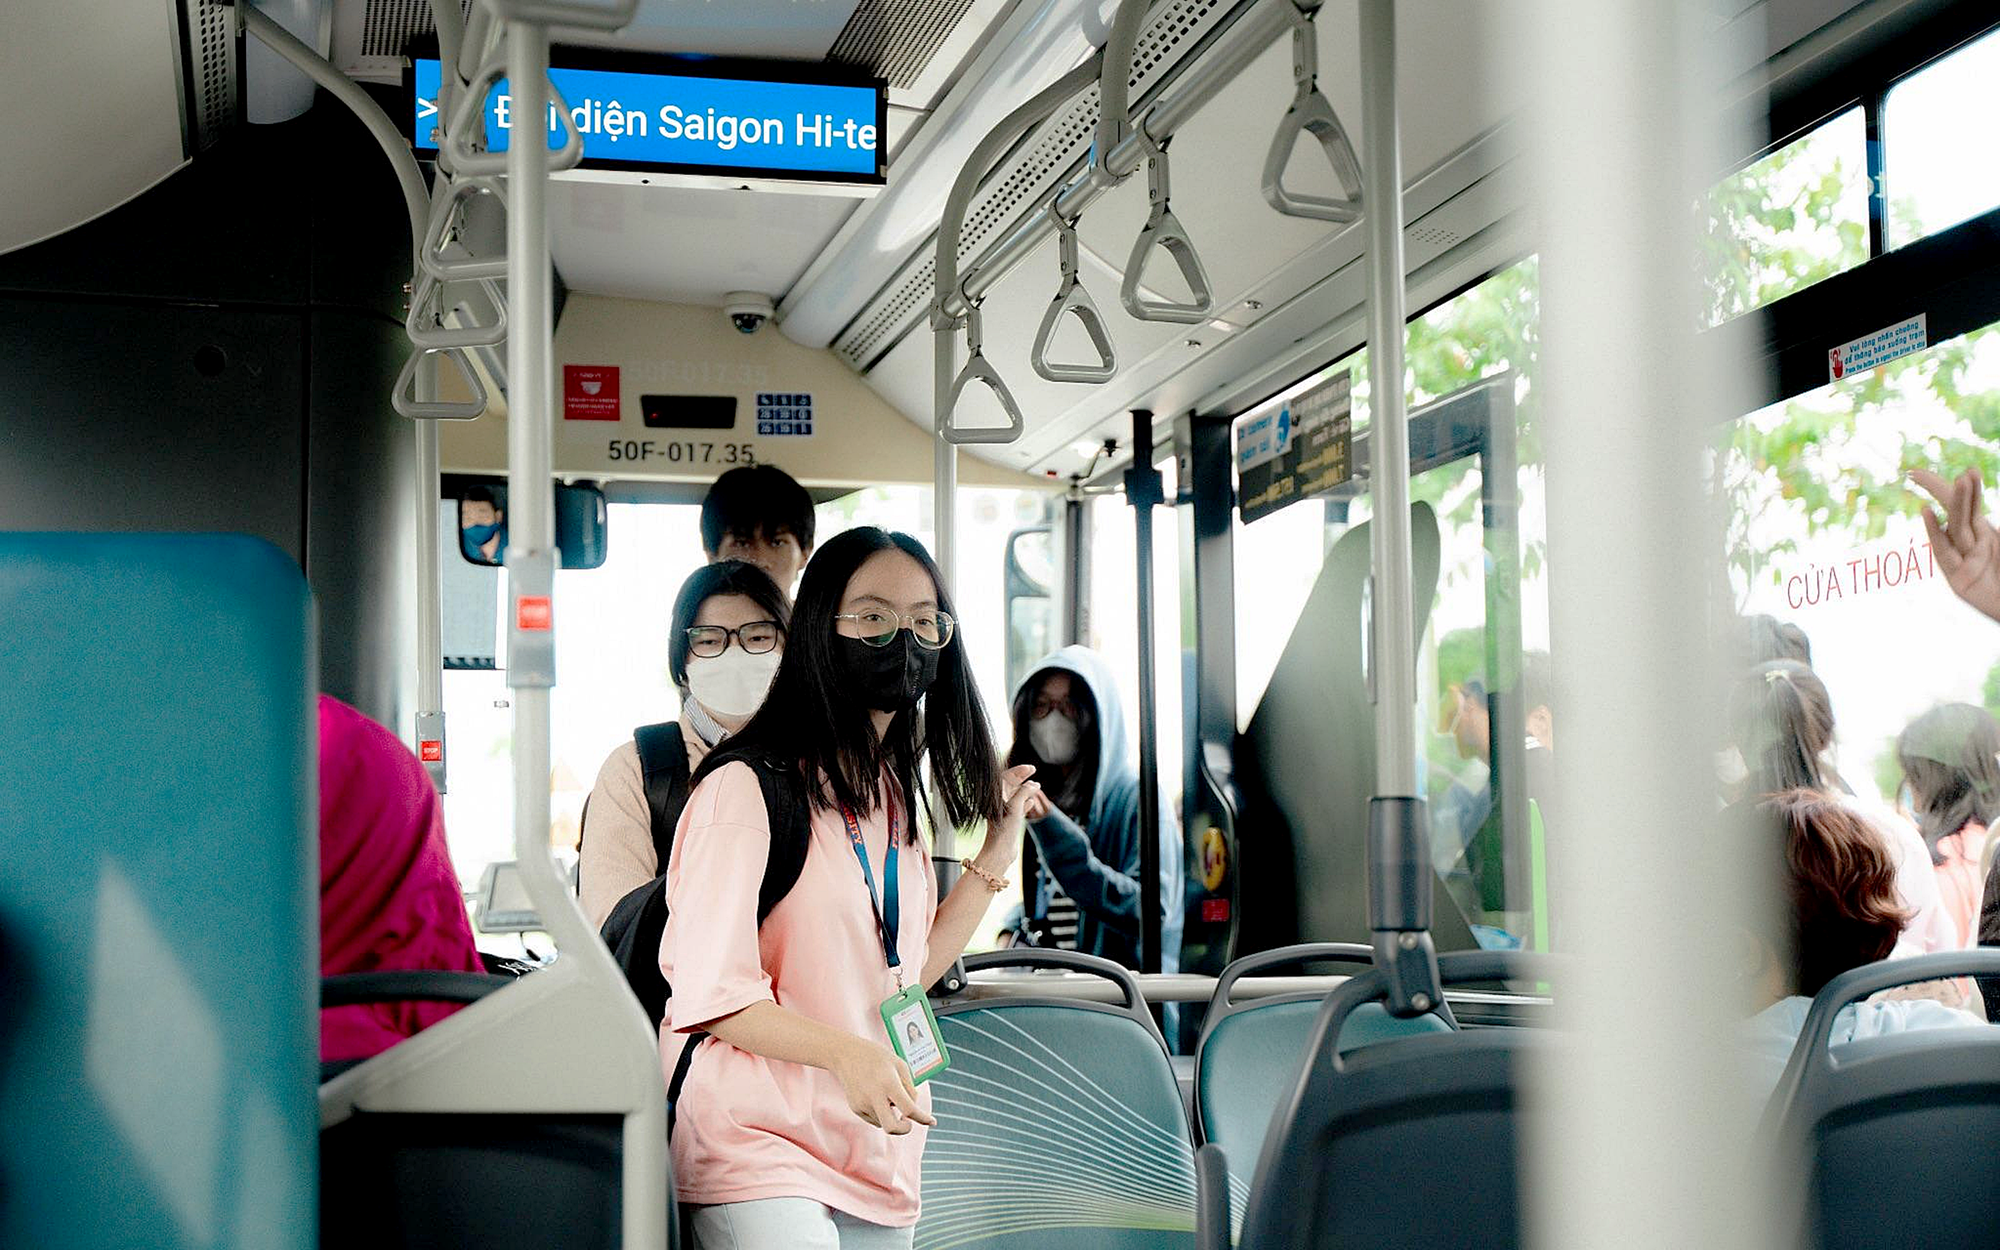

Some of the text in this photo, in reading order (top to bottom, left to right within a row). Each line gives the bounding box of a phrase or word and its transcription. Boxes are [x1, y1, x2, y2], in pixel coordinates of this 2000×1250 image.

[493, 95, 557, 131] Đi
[571, 98, 648, 142] diện
[659, 105, 784, 150] Saigon
[608, 440, 754, 464] 50F-017.35
[1787, 538, 1934, 609] CỬA THOÁT
